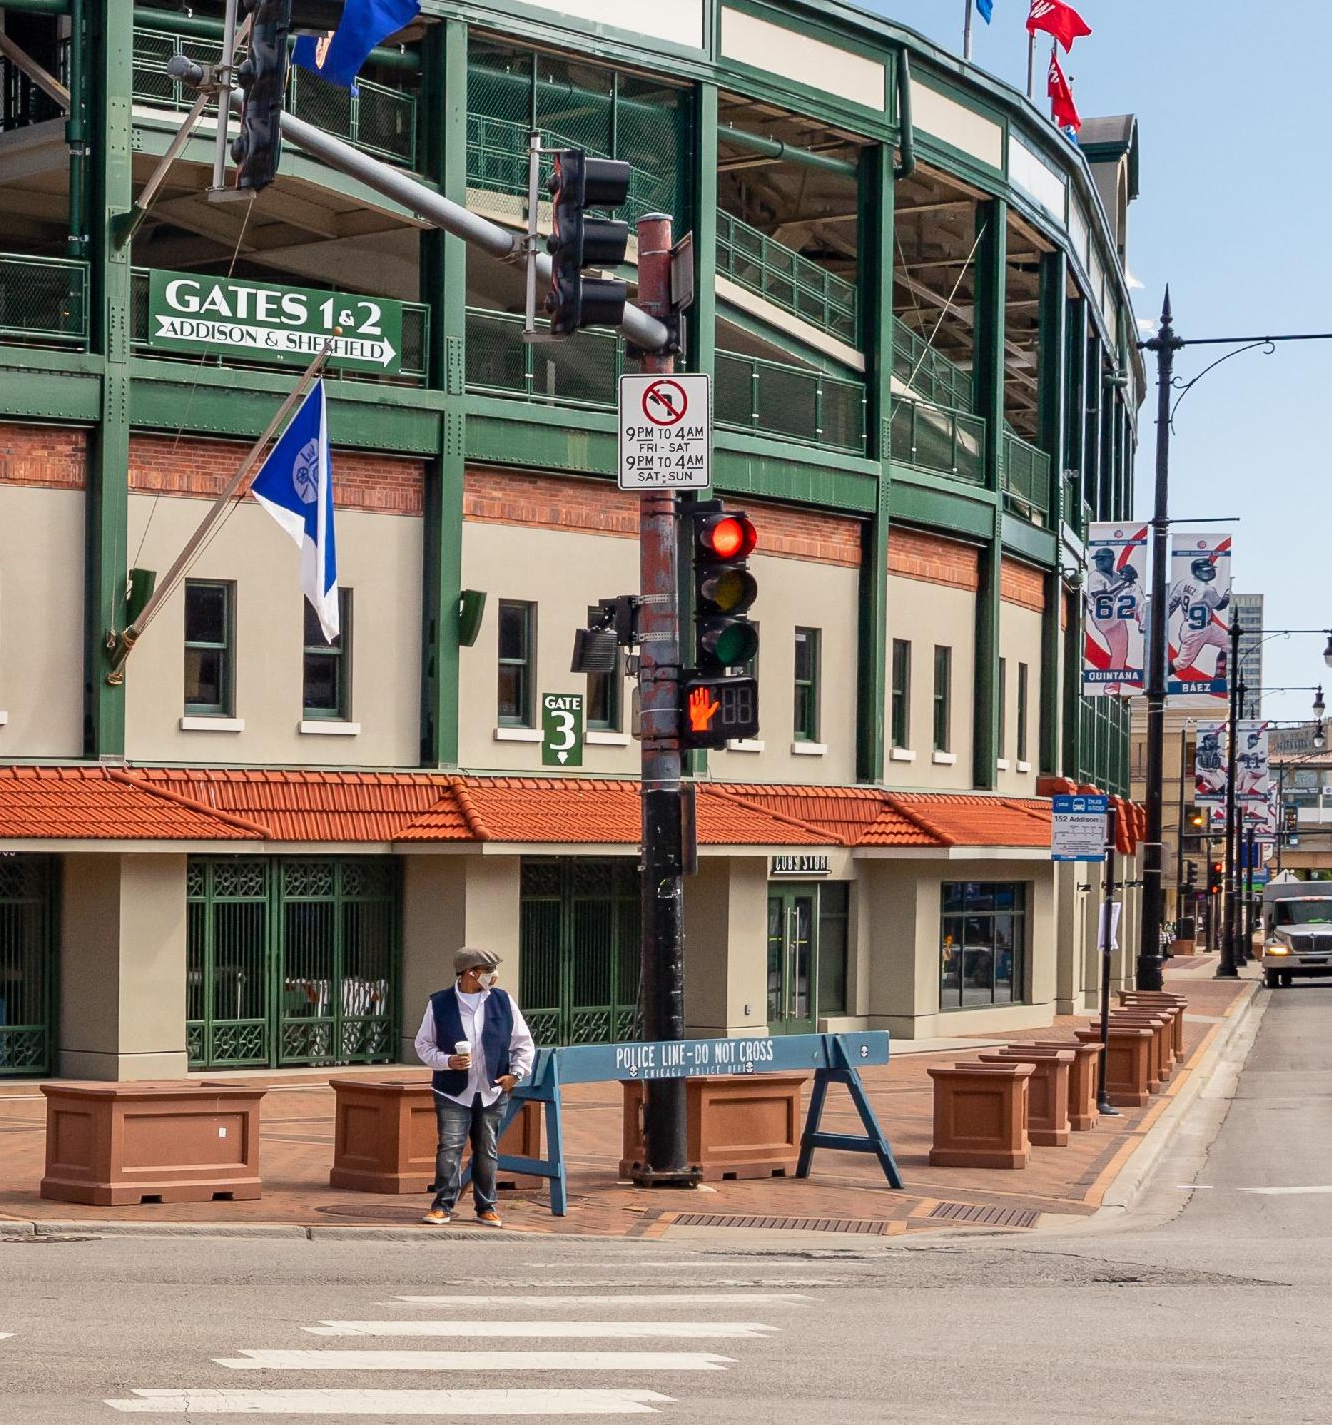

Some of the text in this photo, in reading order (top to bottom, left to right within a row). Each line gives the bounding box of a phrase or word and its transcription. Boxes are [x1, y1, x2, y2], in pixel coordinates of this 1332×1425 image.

[165, 279, 308, 326] GATES
[165, 321, 257, 344] ADDISON
[265, 331, 278, 347] &
[658, 428, 671, 439] TO
[658, 457, 671, 467] TO
[1095, 595, 1136, 620] 62
[1189, 606, 1208, 629] 9
[1089, 671, 1138, 681] QUINTANA
[544, 695, 581, 710] GATE
[549, 710, 576, 749] 3
[616, 1046, 655, 1069] POLICE
[715, 1042, 735, 1064] NOT
[739, 1040, 774, 1062] CROSS
[690, 1065, 720, 1076] POLICE
